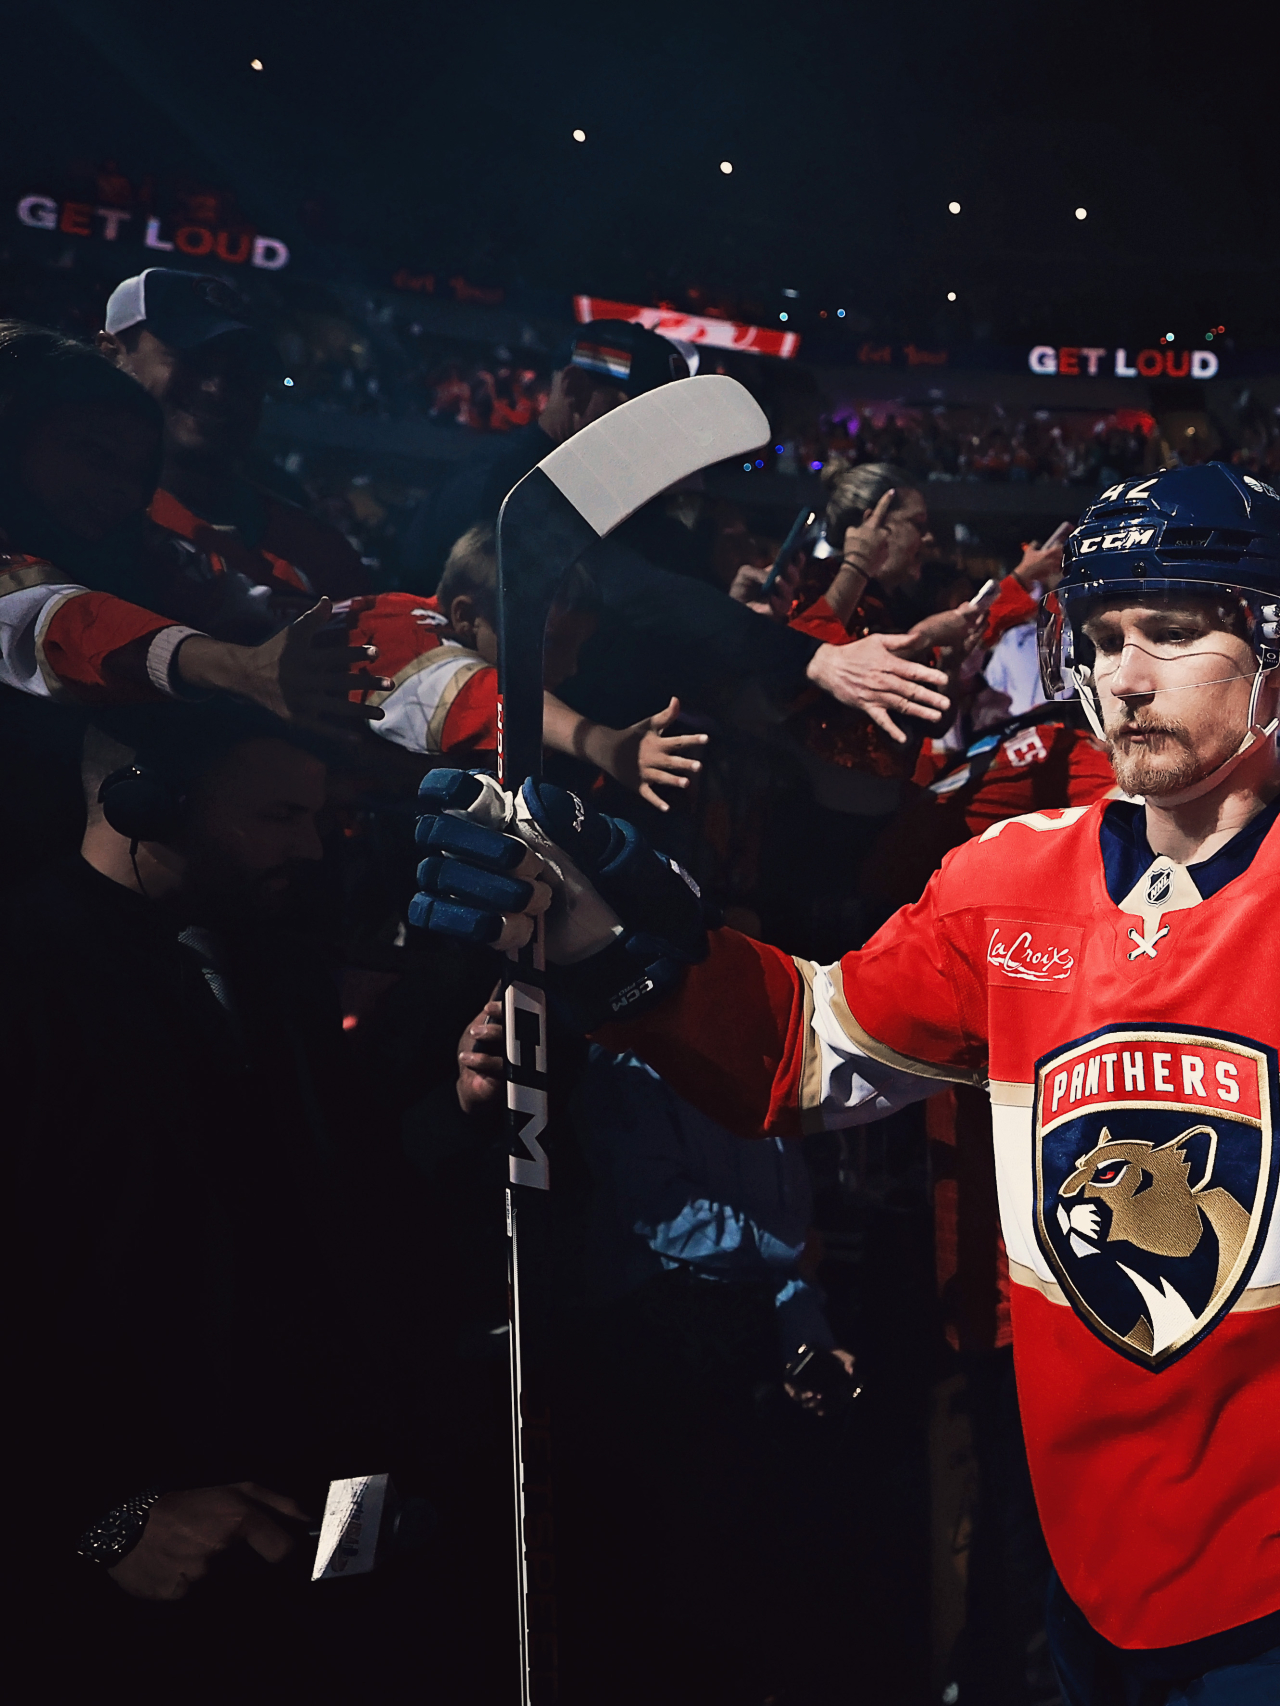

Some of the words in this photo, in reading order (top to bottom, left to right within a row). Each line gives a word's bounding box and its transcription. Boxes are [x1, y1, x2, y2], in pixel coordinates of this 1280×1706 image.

[16, 193, 131, 241] GET
[143, 214, 291, 271] LOUD
[1028, 345, 1106, 376] GET
[1115, 348, 1219, 379] LOUD
[1080, 528, 1156, 554] CCM
[611, 979, 654, 1012] CCM
[1051, 1051, 1240, 1112] PANTHERS
